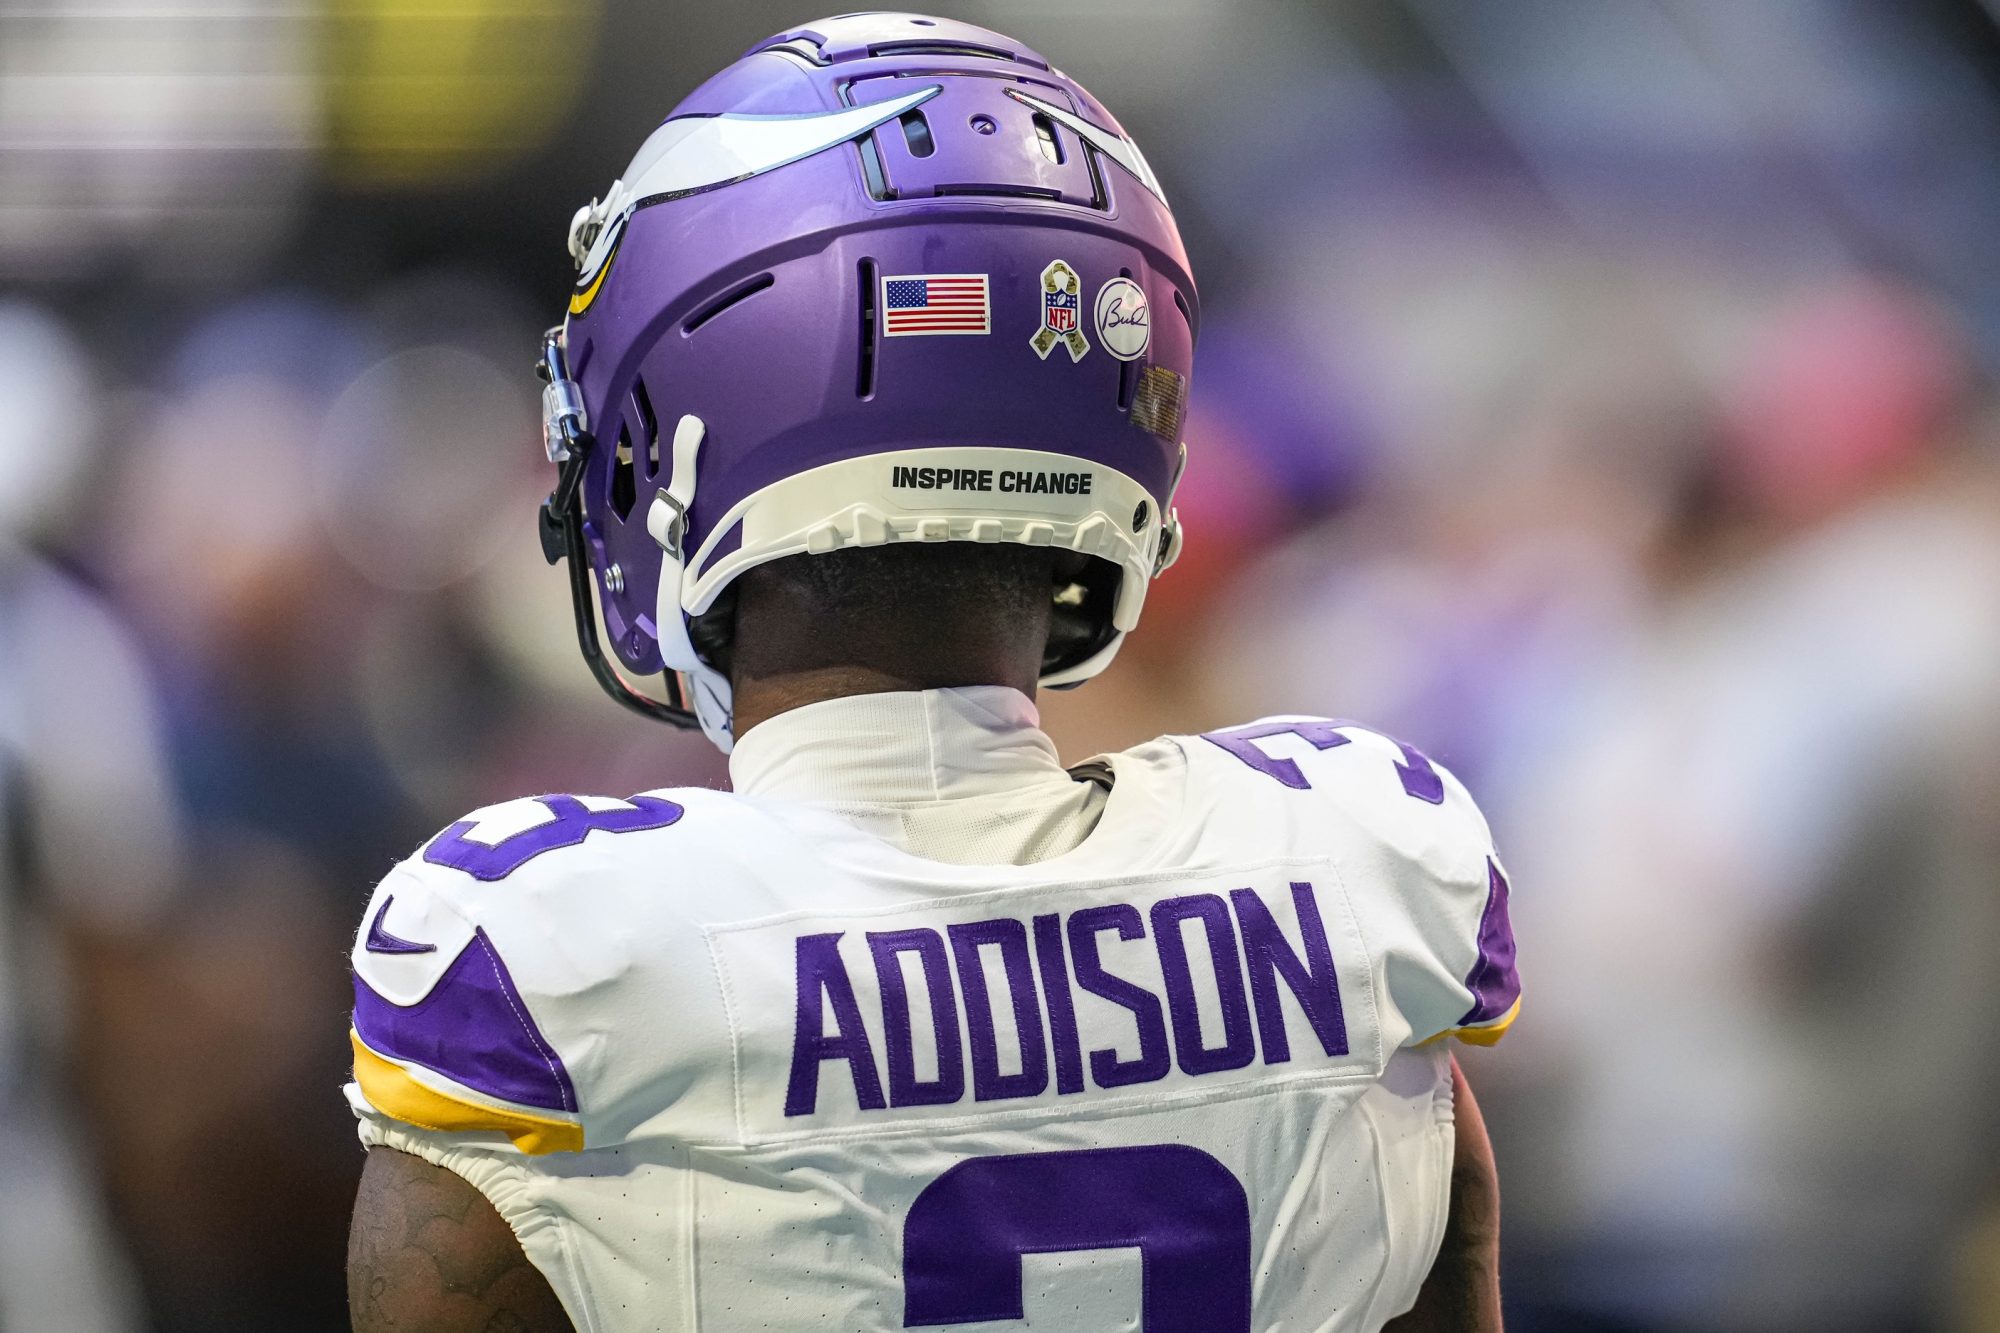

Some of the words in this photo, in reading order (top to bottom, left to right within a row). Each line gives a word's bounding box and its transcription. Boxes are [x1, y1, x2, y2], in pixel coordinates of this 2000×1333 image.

[1047, 307, 1075, 331] NFL
[1102, 297, 1147, 330] Bud
[892, 466, 992, 491] INSPIRE
[998, 469, 1092, 495] CHANGE
[784, 882, 1350, 1117] ADDISON
